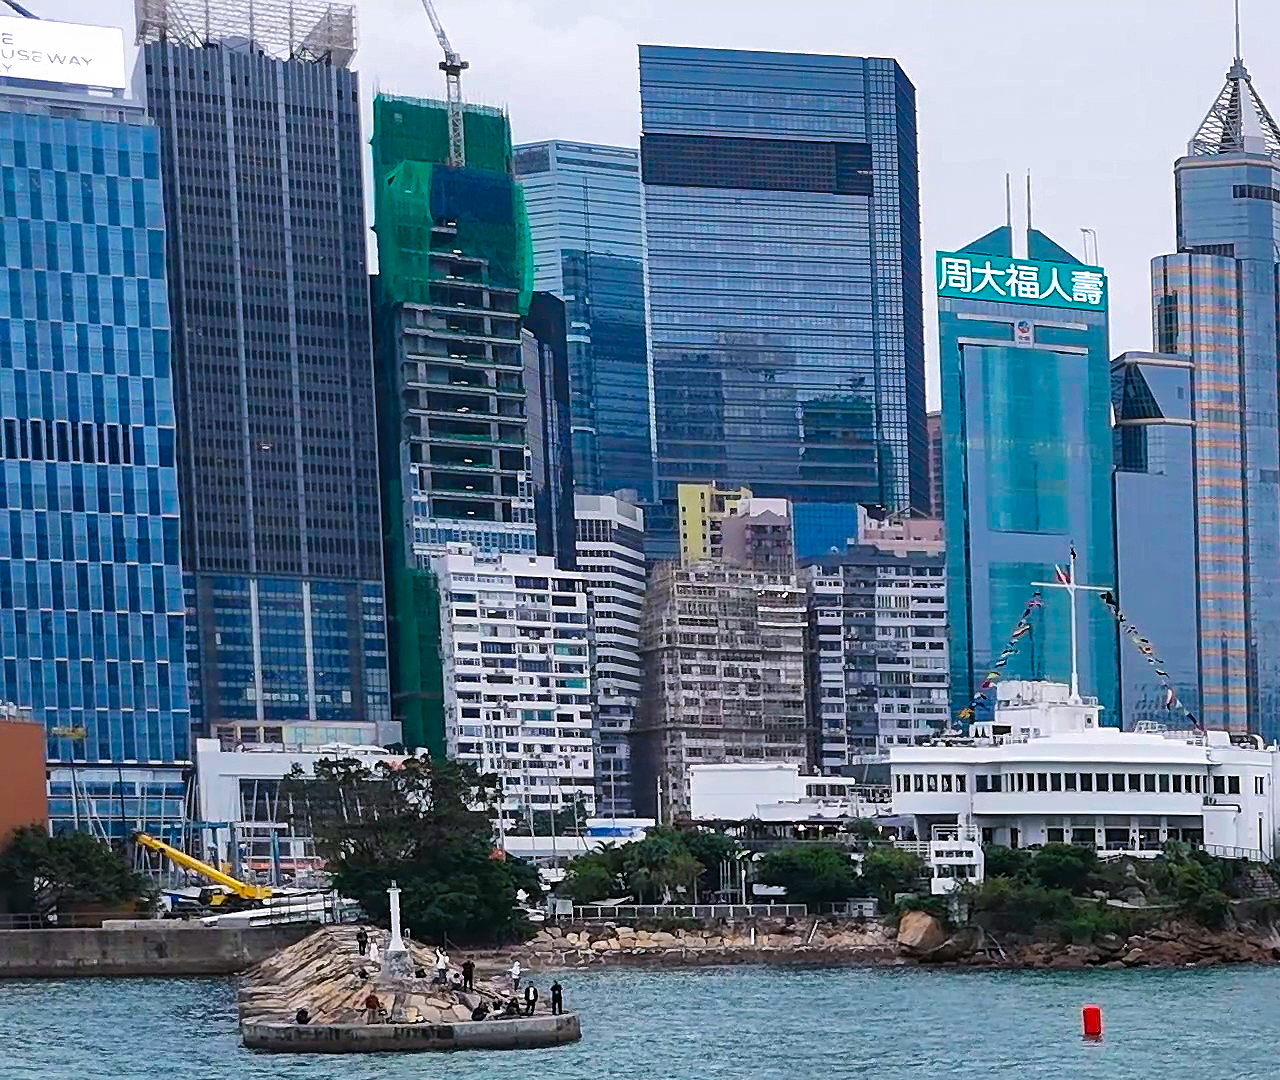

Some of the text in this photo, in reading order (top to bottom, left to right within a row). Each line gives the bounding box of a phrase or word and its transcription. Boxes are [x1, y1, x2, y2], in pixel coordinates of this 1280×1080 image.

[938, 257, 1104, 305] 周大福人壽
